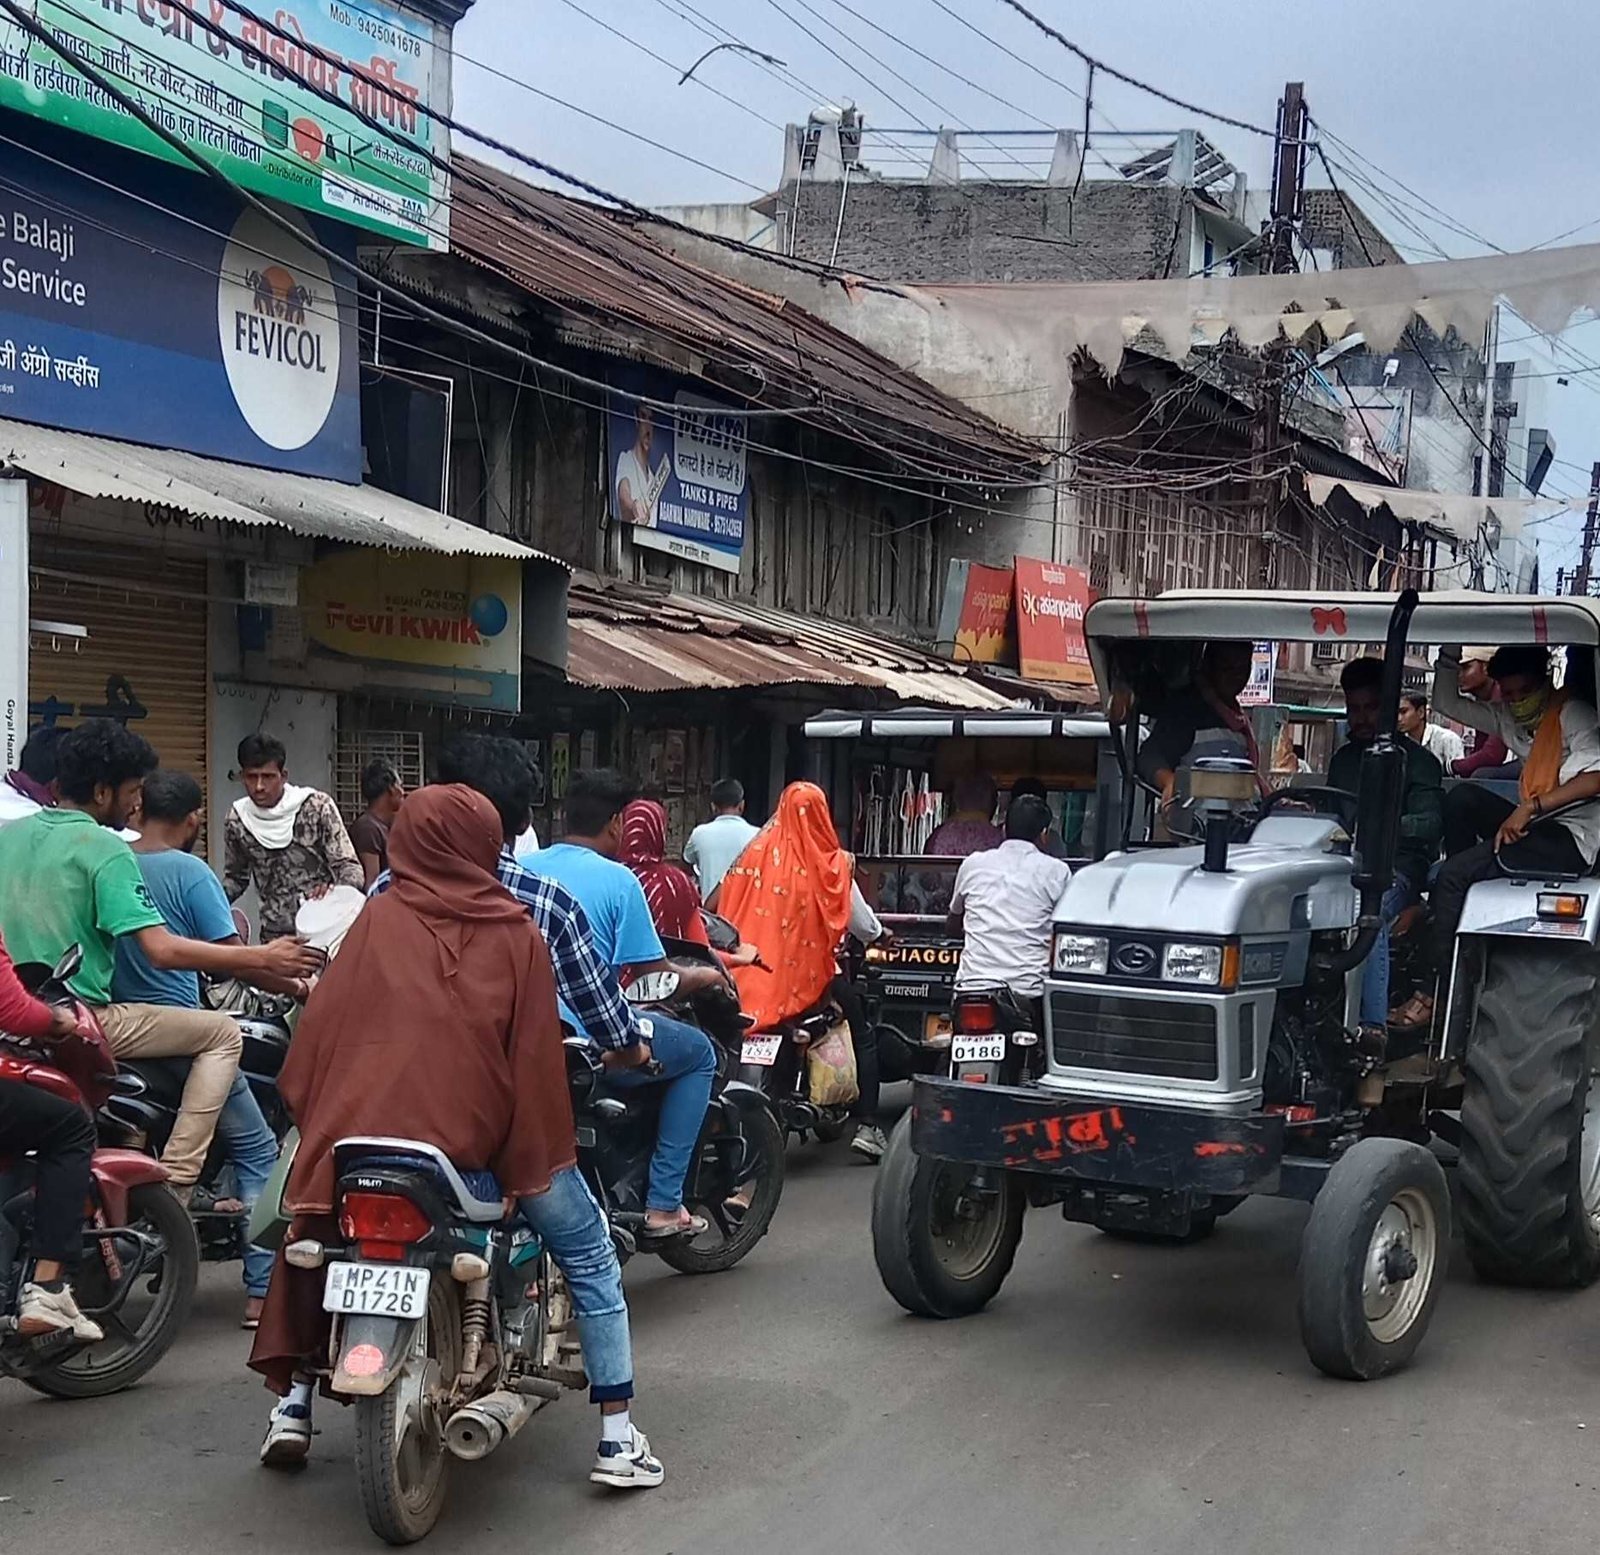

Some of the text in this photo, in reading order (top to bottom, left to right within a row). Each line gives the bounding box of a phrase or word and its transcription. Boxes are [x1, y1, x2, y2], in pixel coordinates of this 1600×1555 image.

[358, 17, 421, 57] 9425041678
[401, 198, 423, 214] TATA
[13, 211, 74, 262] Balaji
[2, 258, 86, 306] Service
[235, 311, 326, 374] FEVICOL
[680, 482, 708, 504] TANKS
[716, 496, 738, 513] PIPES
[5, 699, 16, 766] Goyal Harda
[889, 948, 958, 965] PIAGGI
[955, 1046, 1001, 1059] 0186
[346, 1267, 418, 1293] MP41N
[342, 1291, 412, 1313] D1726
